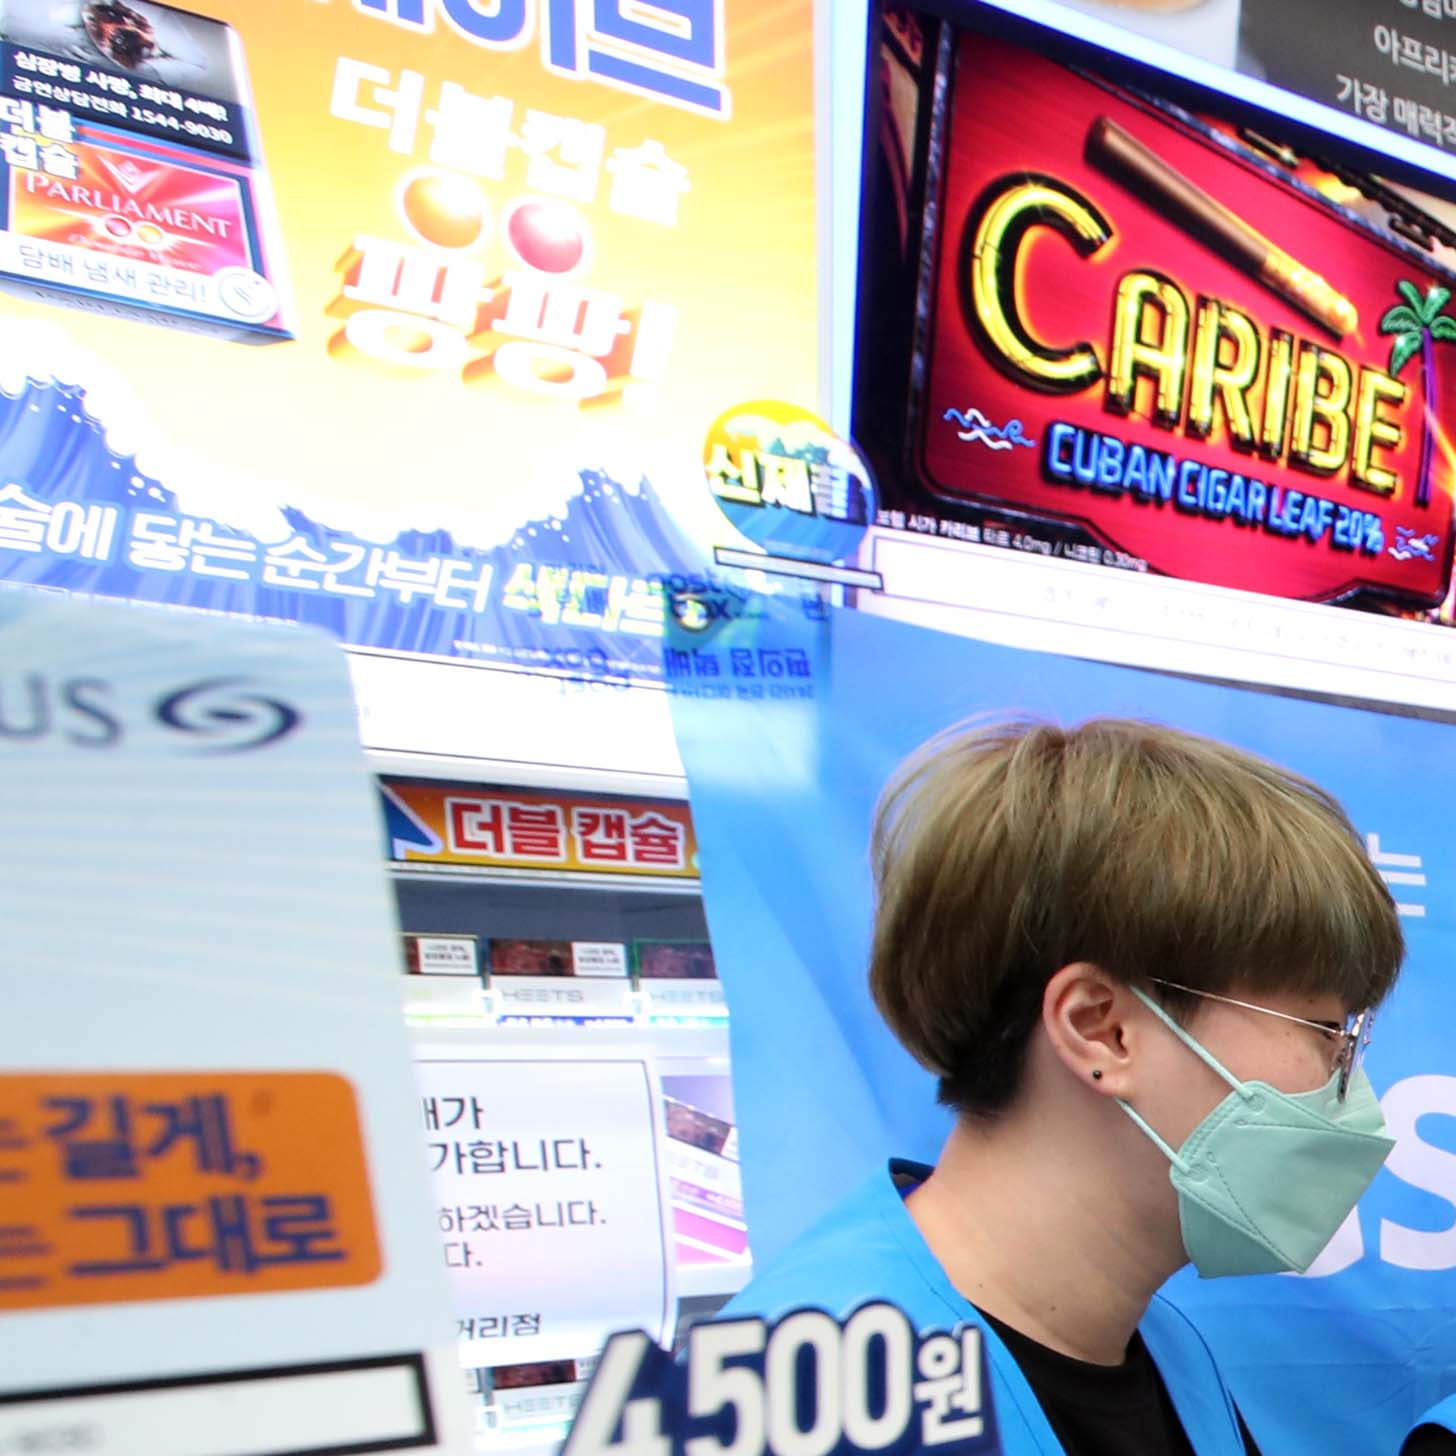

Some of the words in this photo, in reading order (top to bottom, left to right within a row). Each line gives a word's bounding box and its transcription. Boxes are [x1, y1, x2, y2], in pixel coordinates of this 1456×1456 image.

[131, 106, 234, 144] 1544-9030
[1335, 73, 1390, 125] 가장
[25, 172, 232, 238] PARLIAMENT
[84, 258, 138, 289] 냄새
[958, 170, 1409, 498] CARIBE
[1046, 421, 1176, 503] CUBAN
[1177, 451, 1268, 531] CIGAR
[1268, 483, 1333, 541] LEAF
[1332, 503, 1385, 559] 20%
[129, 511, 257, 580] 닿는
[262, 535, 494, 613] 순간부터
[446, 797, 566, 862] 더블
[573, 805, 686, 871] 캡슐
[42, 1090, 263, 1182] 길게,
[67, 1194, 348, 1278] 그대로
[439, 1200, 607, 1234] 하겠습니다.
